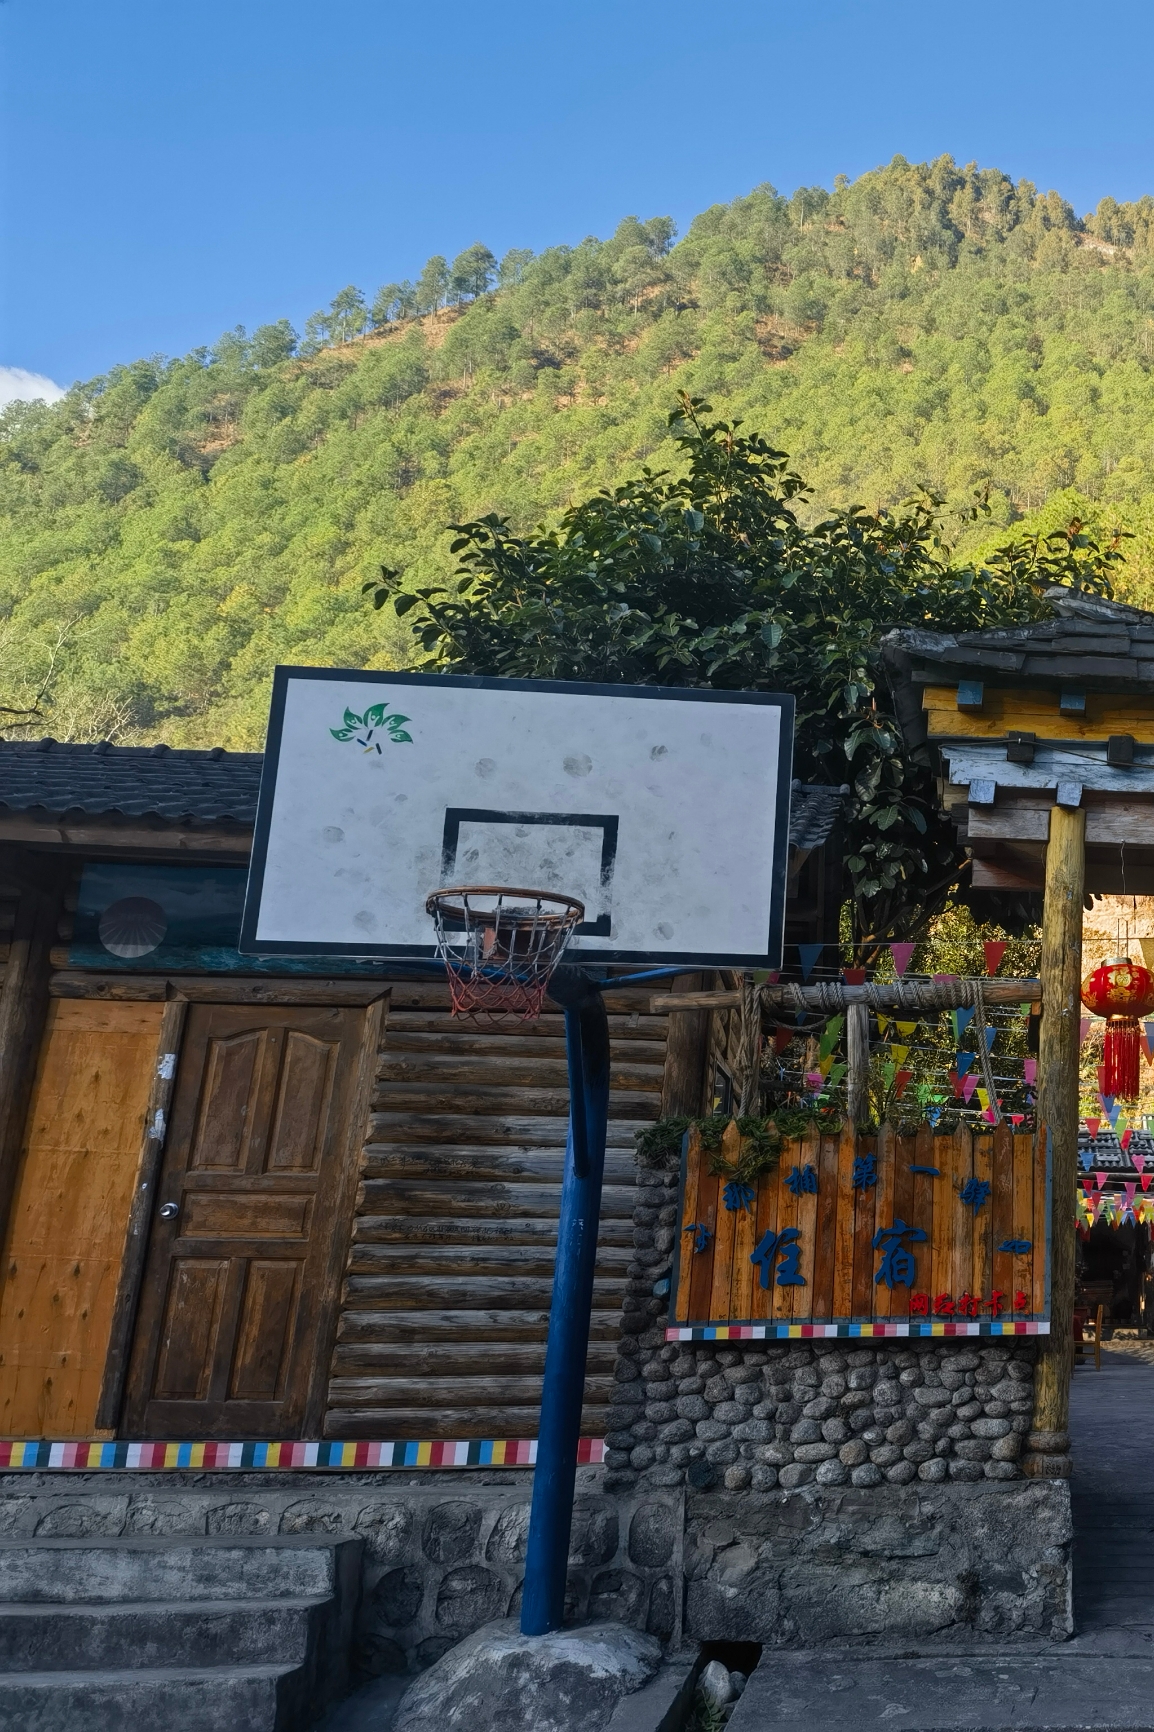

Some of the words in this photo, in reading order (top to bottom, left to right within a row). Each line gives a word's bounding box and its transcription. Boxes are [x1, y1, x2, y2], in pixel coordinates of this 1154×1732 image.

[750, 1218, 928, 1290] 住宿
[909, 1289, 1031, 1317] 网红打卡点
